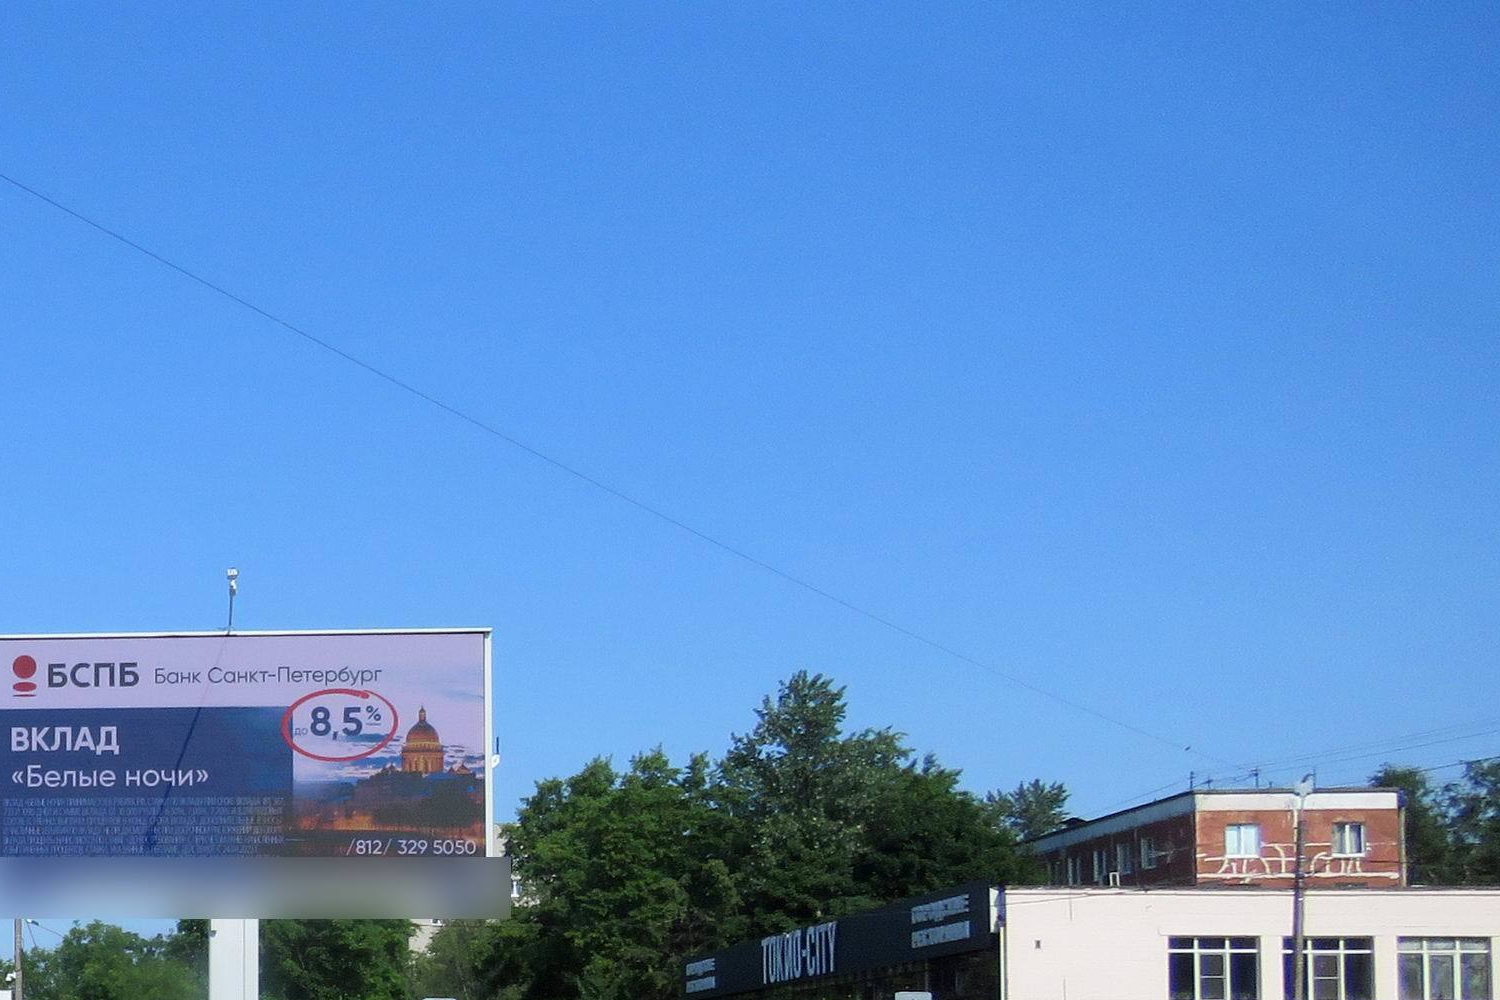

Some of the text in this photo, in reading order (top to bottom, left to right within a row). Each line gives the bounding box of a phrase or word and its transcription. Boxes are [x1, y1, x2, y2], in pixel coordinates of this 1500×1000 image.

[47, 662, 382, 688] БСПБ Банк Санкт-Петербург
[11, 726, 120, 756] ВКЛАД
[11, 764, 209, 788] «Белые ночи»
[346, 838, 477, 856] /812/ 329 5050
